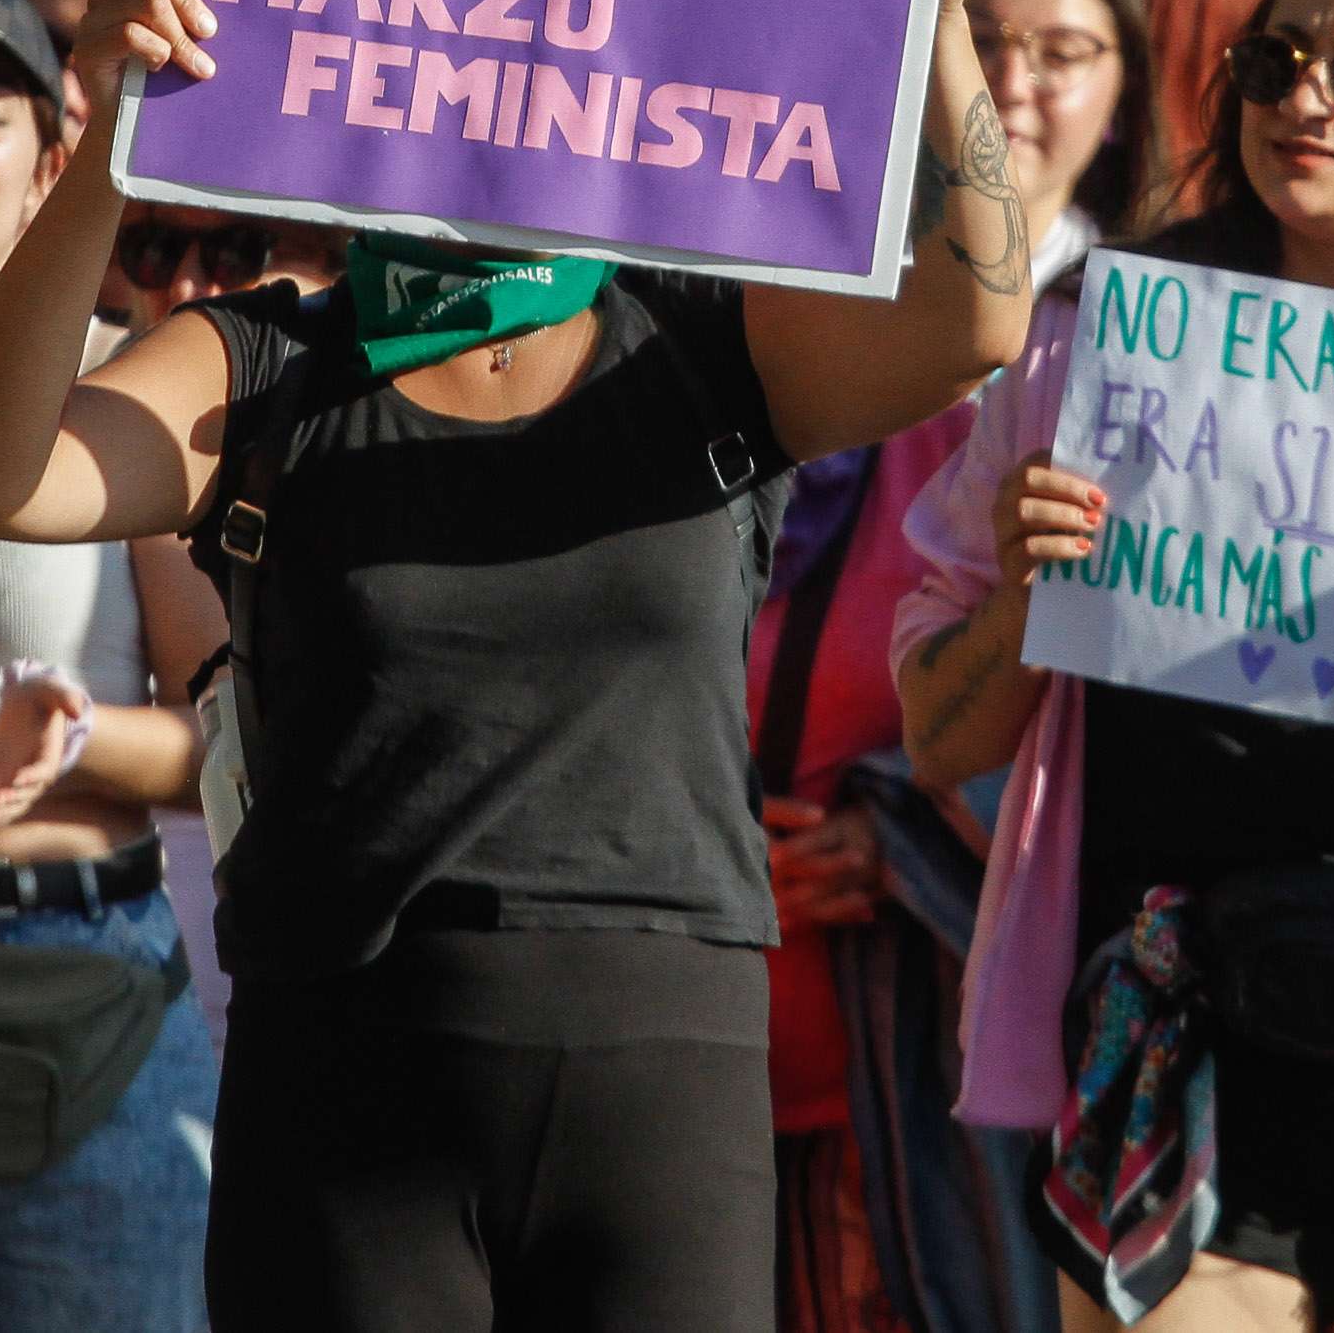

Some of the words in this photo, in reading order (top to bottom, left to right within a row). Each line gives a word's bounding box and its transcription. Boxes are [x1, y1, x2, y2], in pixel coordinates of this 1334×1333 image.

[281, 29, 842, 192] FEMINISTA
[1096, 266, 1189, 361] NO
[1092, 380, 1220, 481] ERA
[1217, 530, 1322, 644] MÁS
